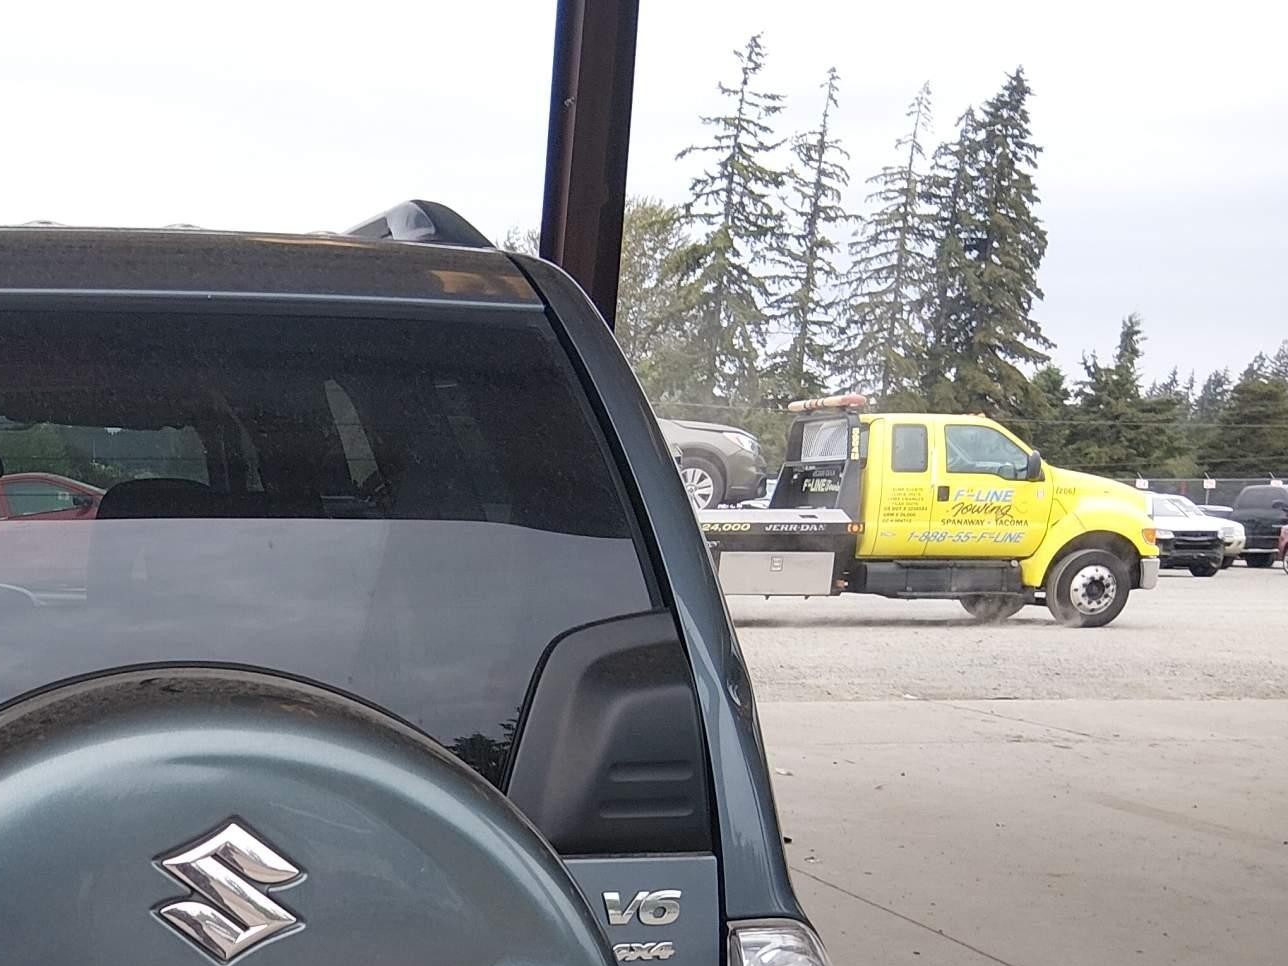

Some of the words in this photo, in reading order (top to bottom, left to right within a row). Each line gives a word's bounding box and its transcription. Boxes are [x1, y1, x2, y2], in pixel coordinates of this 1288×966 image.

[951, 502, 1014, 521] Towing
[701, 523, 751, 533] 24,000
[940, 519, 985, 527] SPANAWAY
[995, 519, 1029, 527] TACOMA
[601, 889, 682, 926] V6
